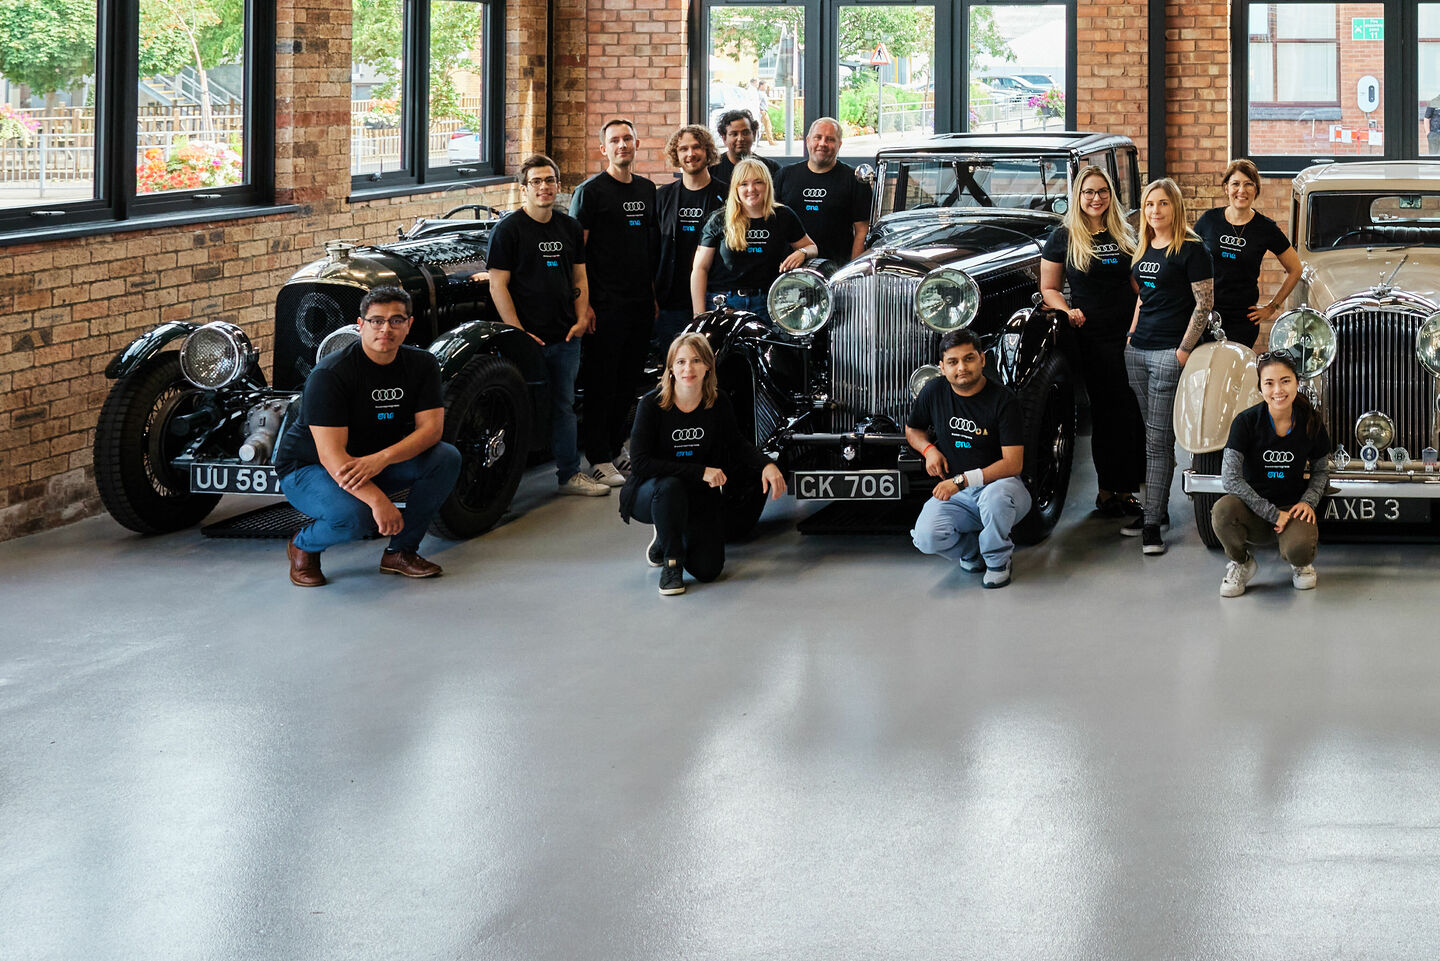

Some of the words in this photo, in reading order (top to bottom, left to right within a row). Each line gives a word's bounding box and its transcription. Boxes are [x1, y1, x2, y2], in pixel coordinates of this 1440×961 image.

[196, 466, 228, 490] UU
[800, 475, 835, 498] GK
[844, 474, 895, 498] 706
[1324, 498, 1376, 520] AXB
[1384, 498, 1400, 520] 3
